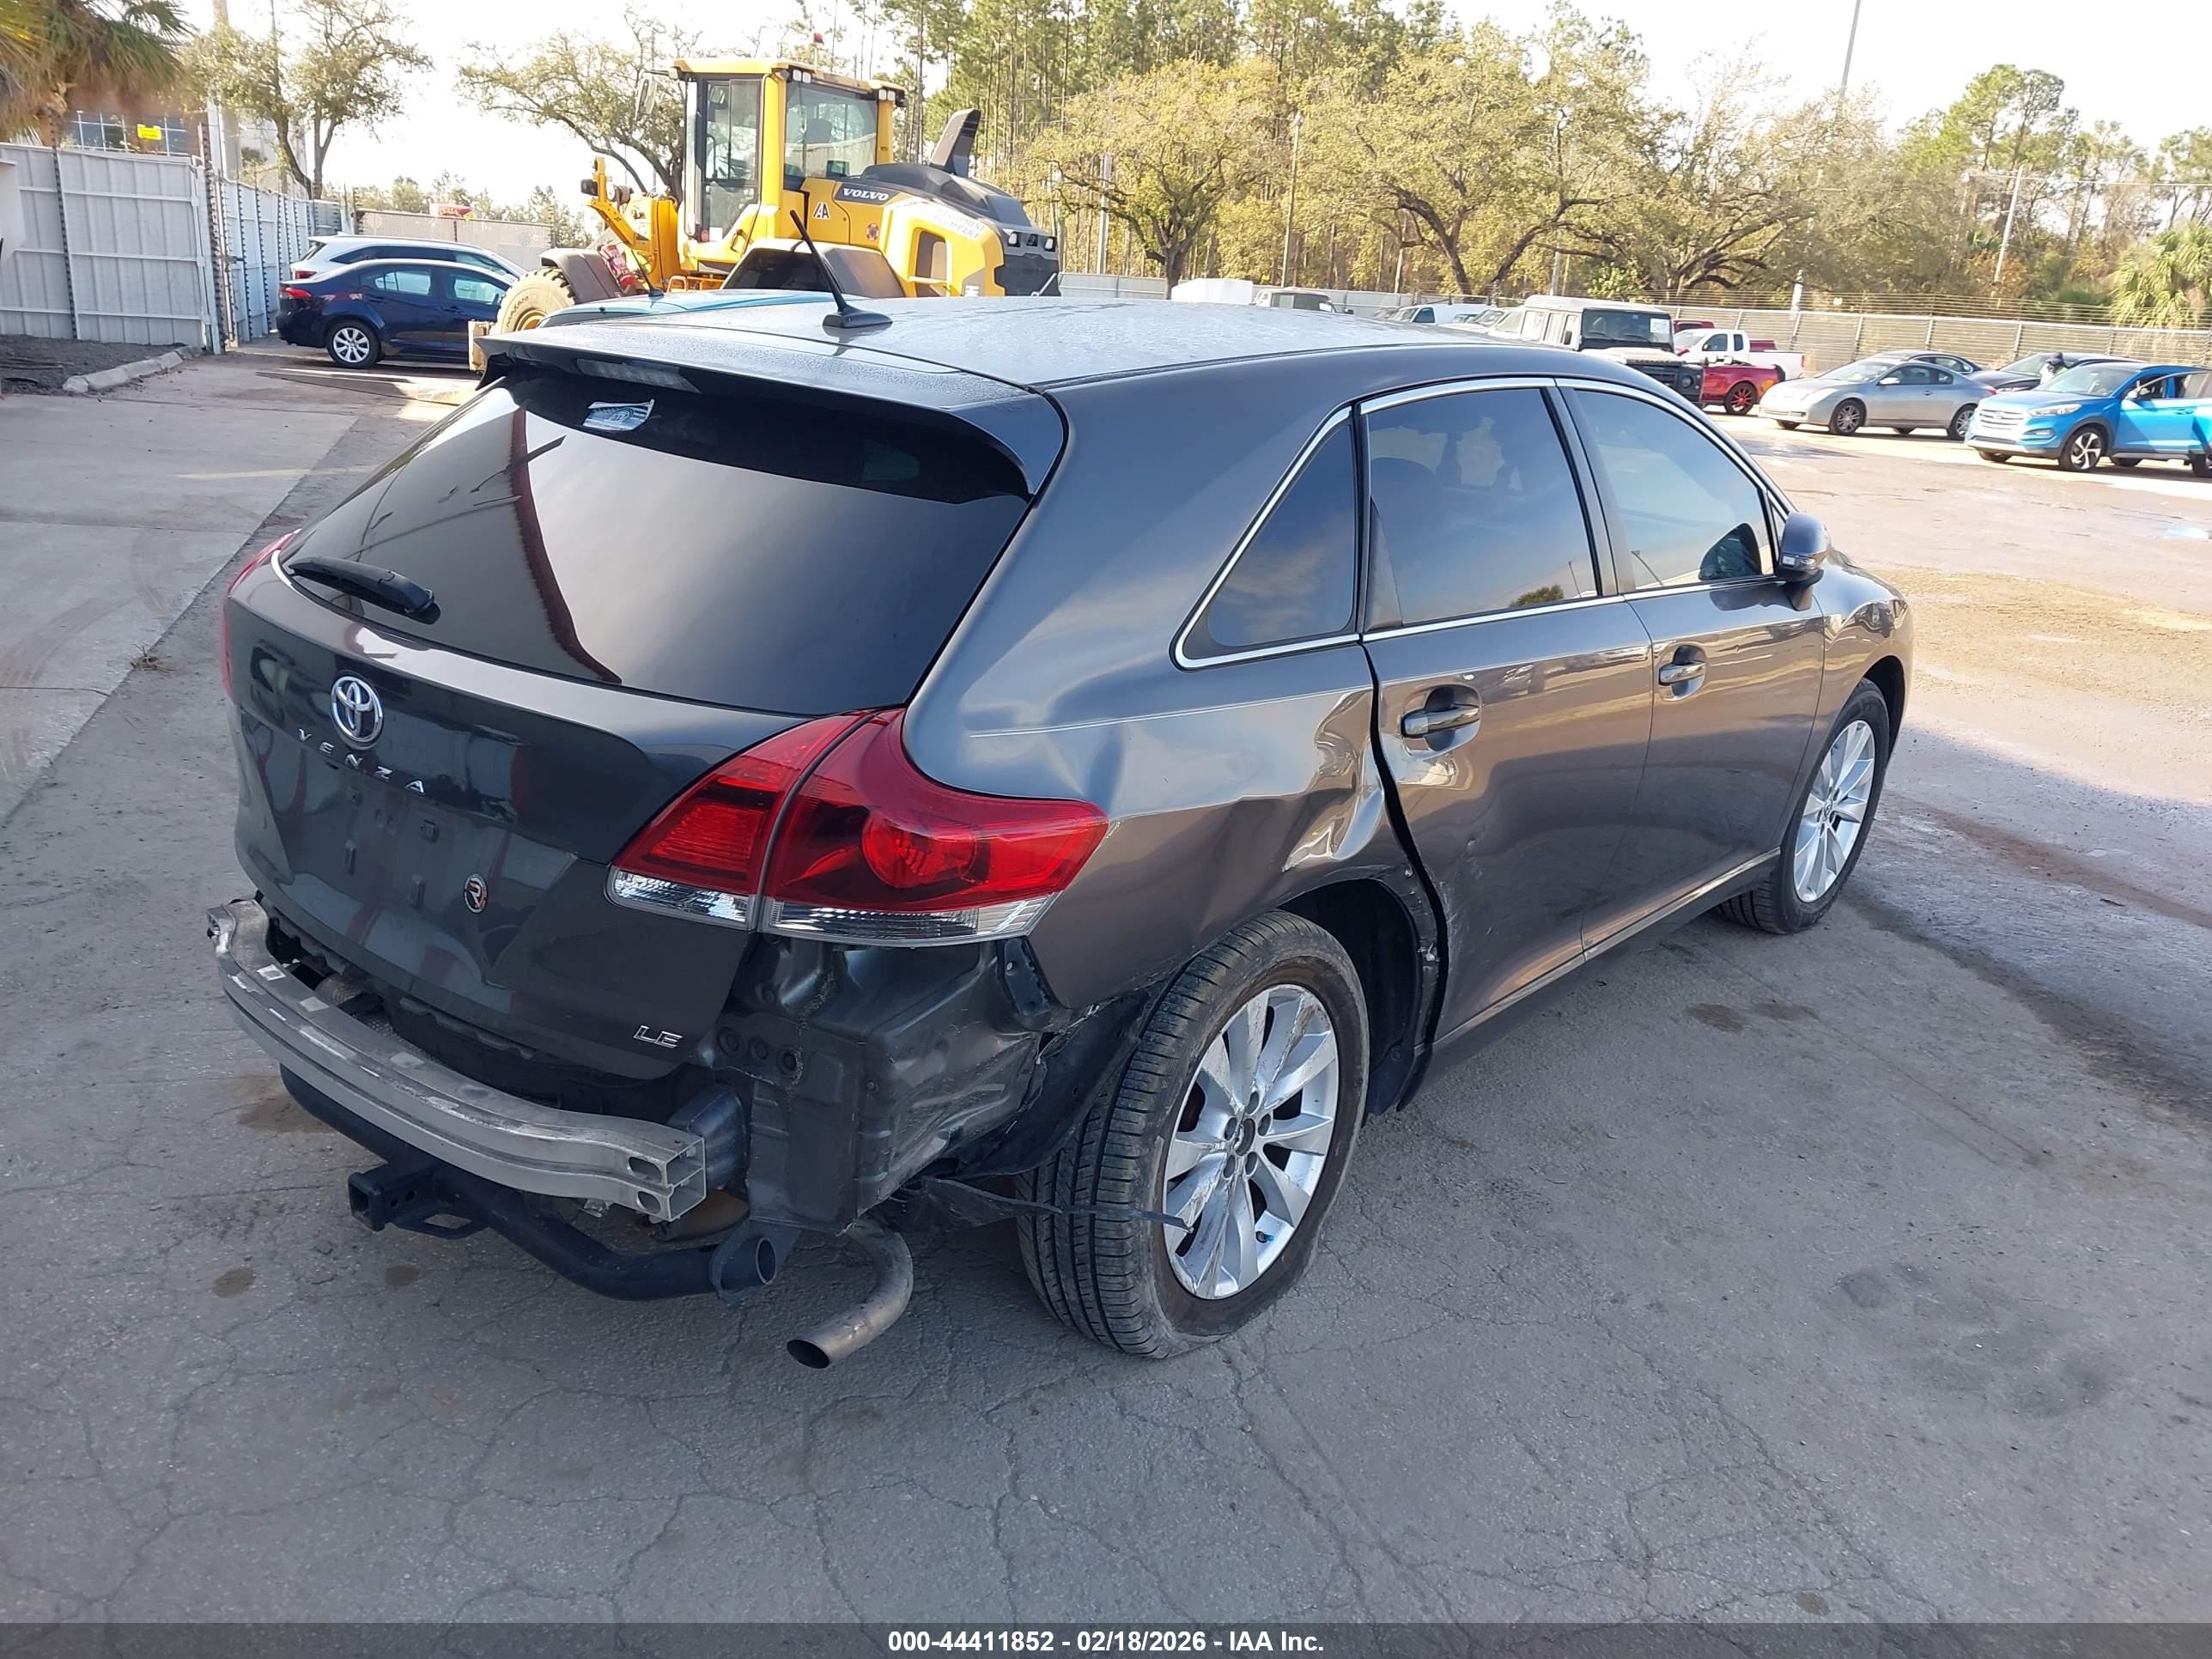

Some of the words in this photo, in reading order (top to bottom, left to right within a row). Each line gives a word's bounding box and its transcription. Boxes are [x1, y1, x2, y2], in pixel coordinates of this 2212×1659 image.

[843, 188, 890, 201] VOLVO
[933, 214, 981, 239] MPANY
[937, 207, 986, 232] PMENT
[298, 728, 425, 795] VENZA
[633, 1024, 684, 1048] LE
